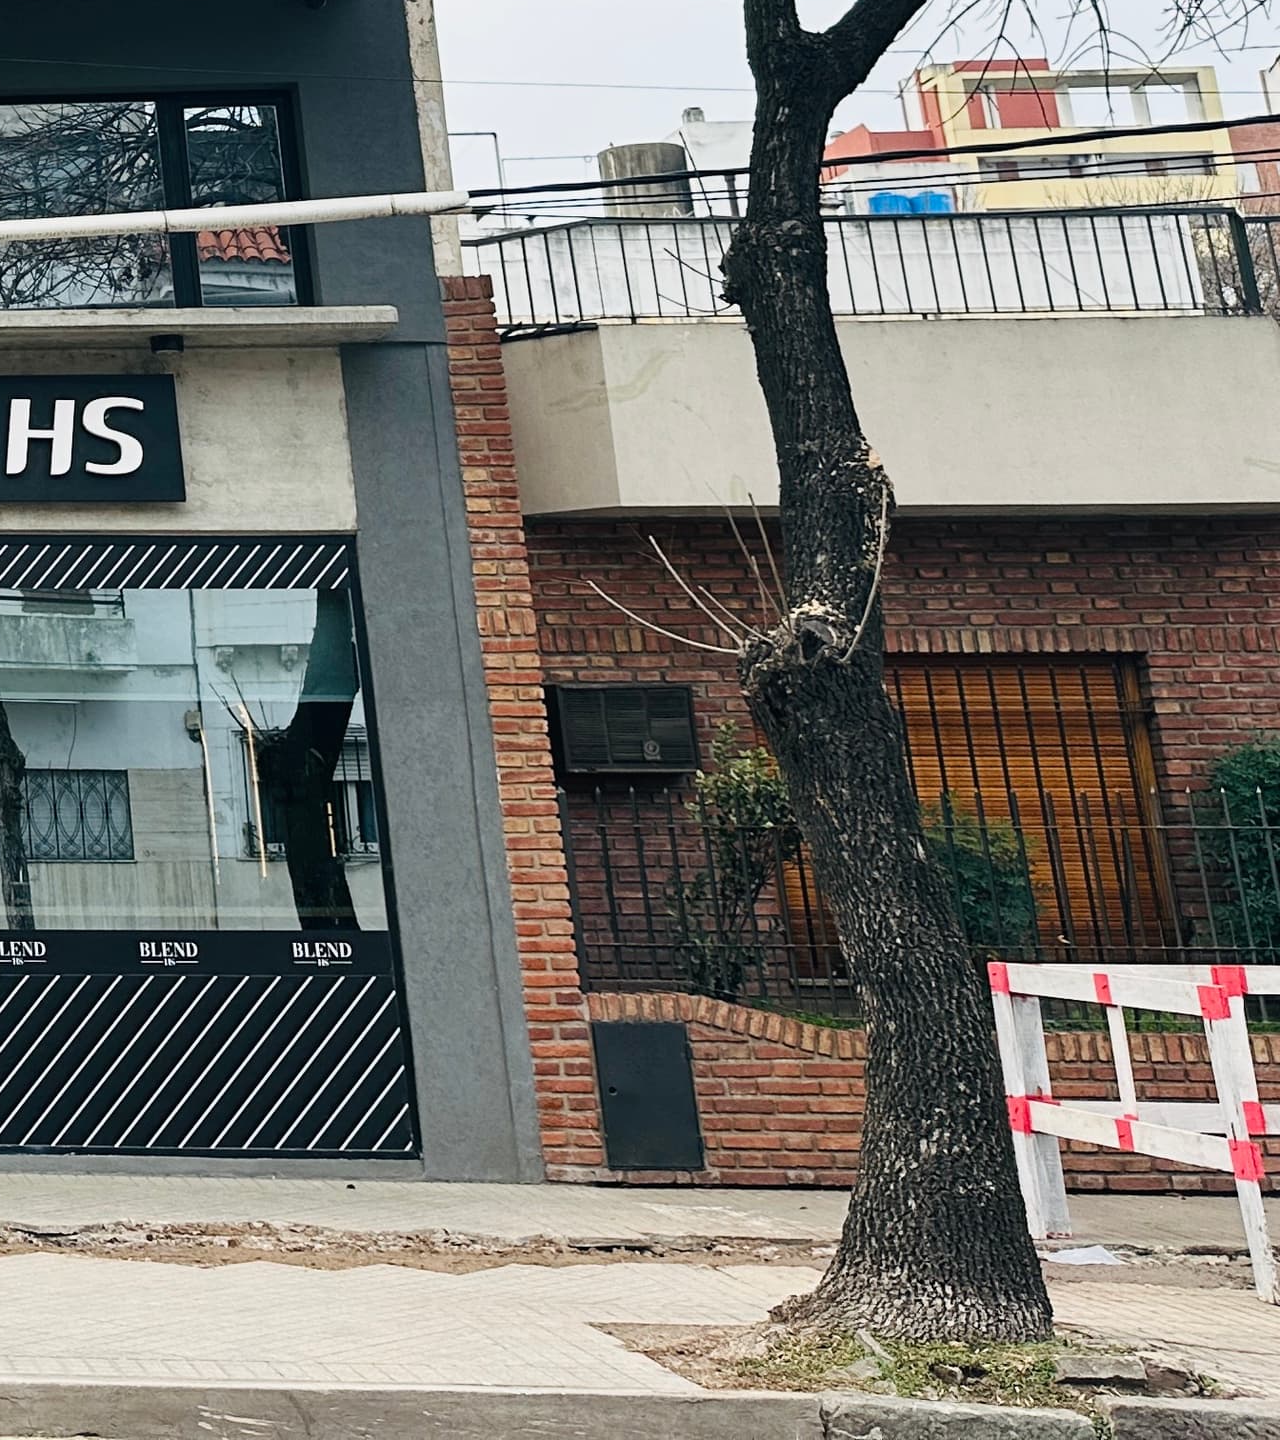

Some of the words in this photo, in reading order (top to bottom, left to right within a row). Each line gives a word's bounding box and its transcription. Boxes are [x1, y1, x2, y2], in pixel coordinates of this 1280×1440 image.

[5, 396, 145, 476] HS
[139, 942, 198, 958] BLEND
[292, 942, 352, 958] BLEND
